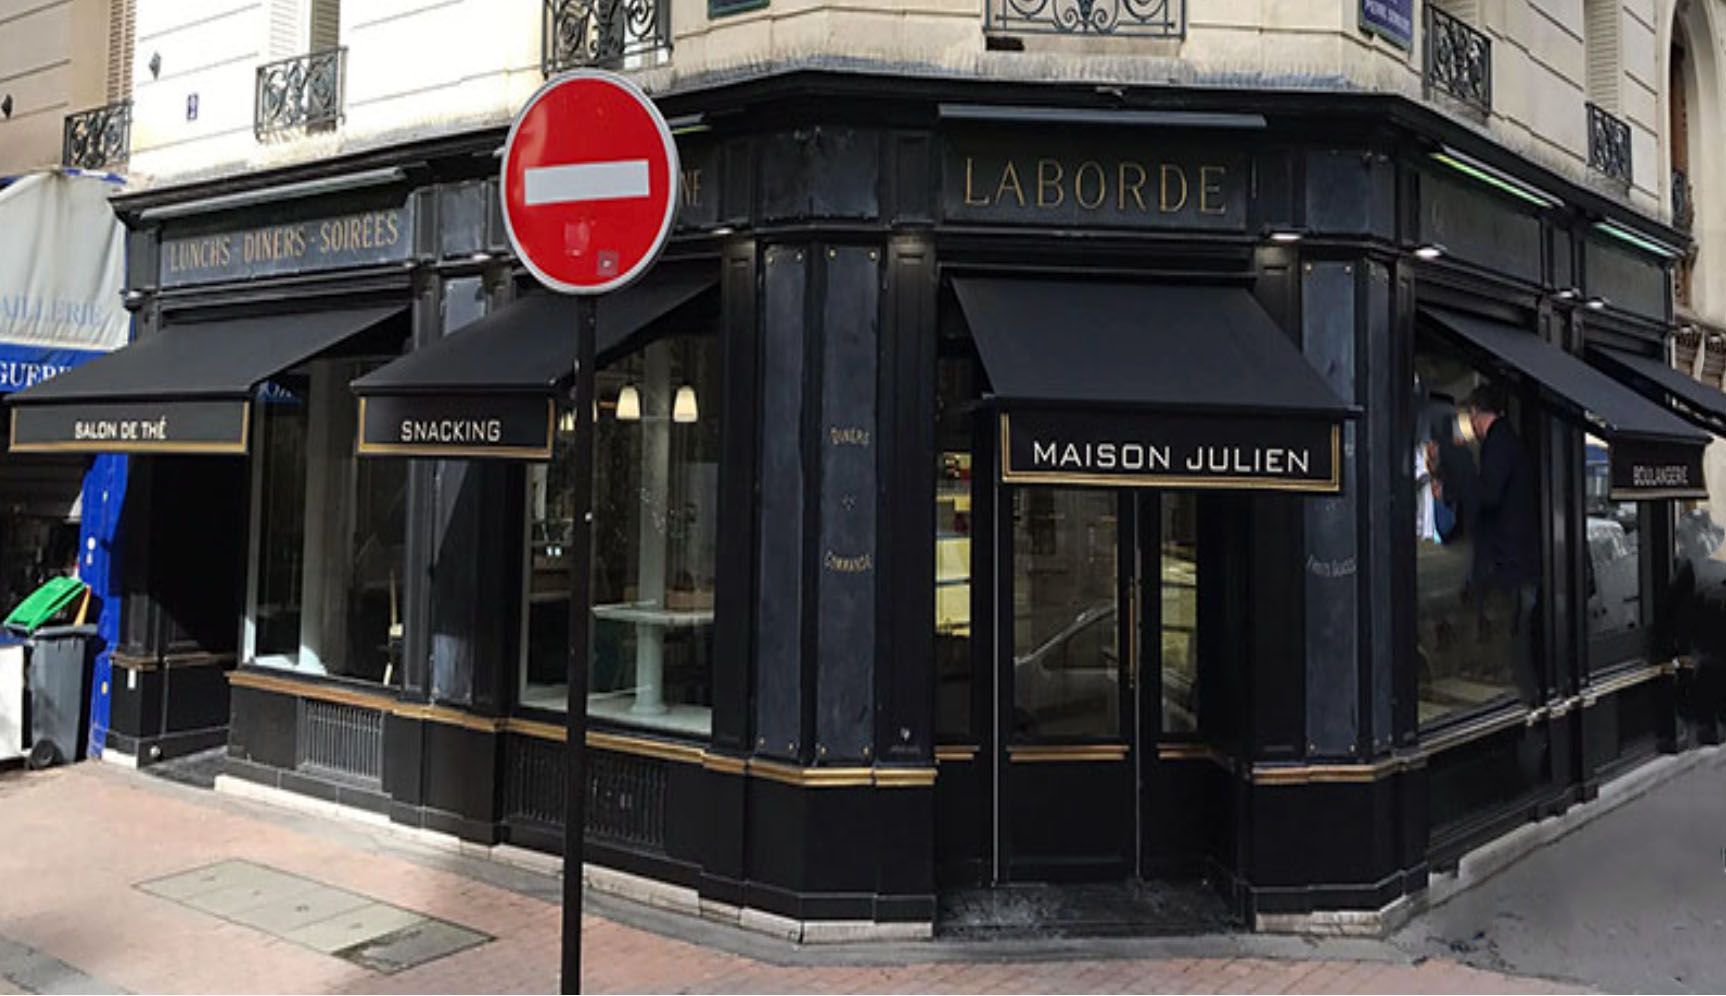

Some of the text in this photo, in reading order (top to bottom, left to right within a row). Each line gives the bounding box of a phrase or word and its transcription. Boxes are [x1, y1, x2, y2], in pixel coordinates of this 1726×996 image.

[965, 156, 1226, 214] LABORDE
[169, 236, 231, 273] LUNCHS
[243, 226, 306, 263] DINERS
[75, 415, 167, 439] SALON DE THÉ
[400, 420, 501, 442] SNACKING
[1033, 441, 1309, 473] MAISON JULIEN
